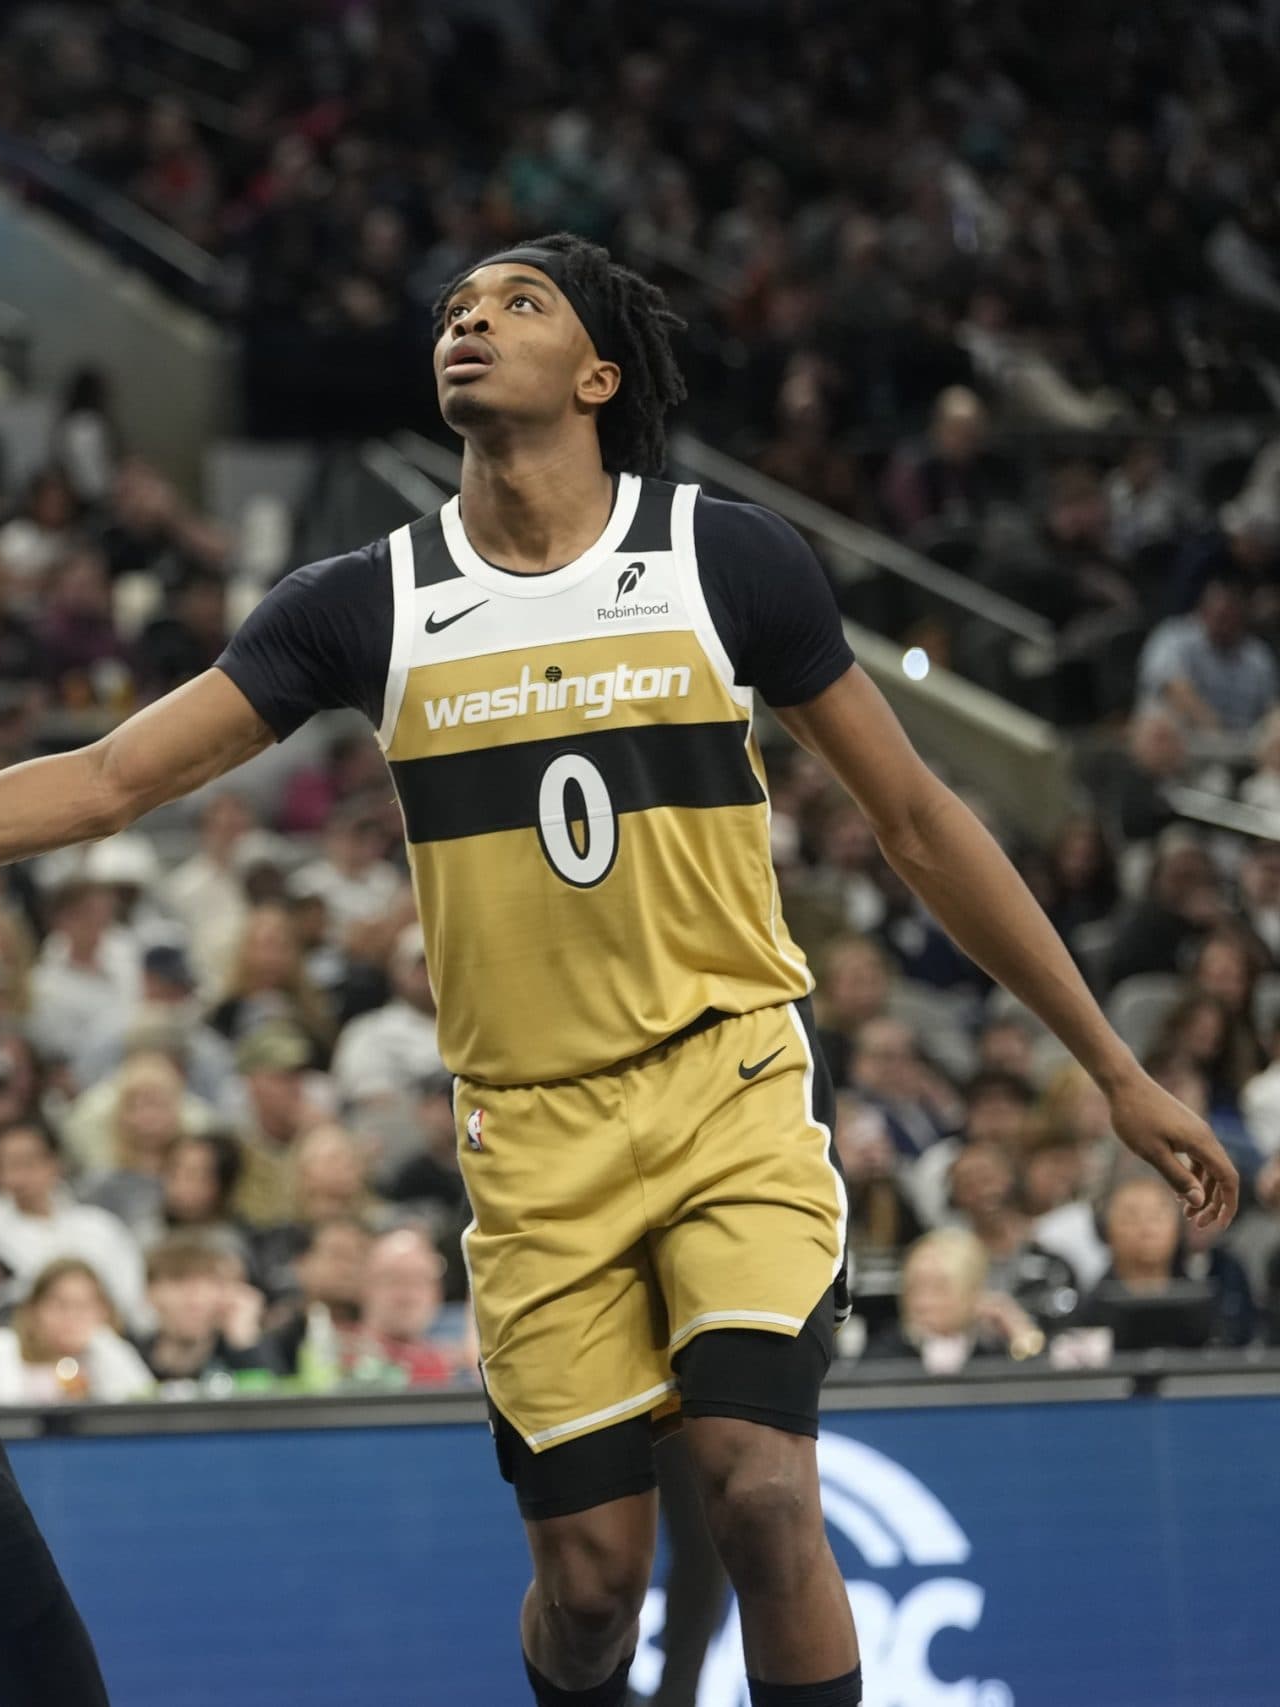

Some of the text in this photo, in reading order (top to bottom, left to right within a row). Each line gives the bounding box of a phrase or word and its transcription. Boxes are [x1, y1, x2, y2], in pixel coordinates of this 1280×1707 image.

[596, 601, 670, 621] Robinhood
[423, 662, 691, 731] washington
[535, 749, 619, 890] 0
